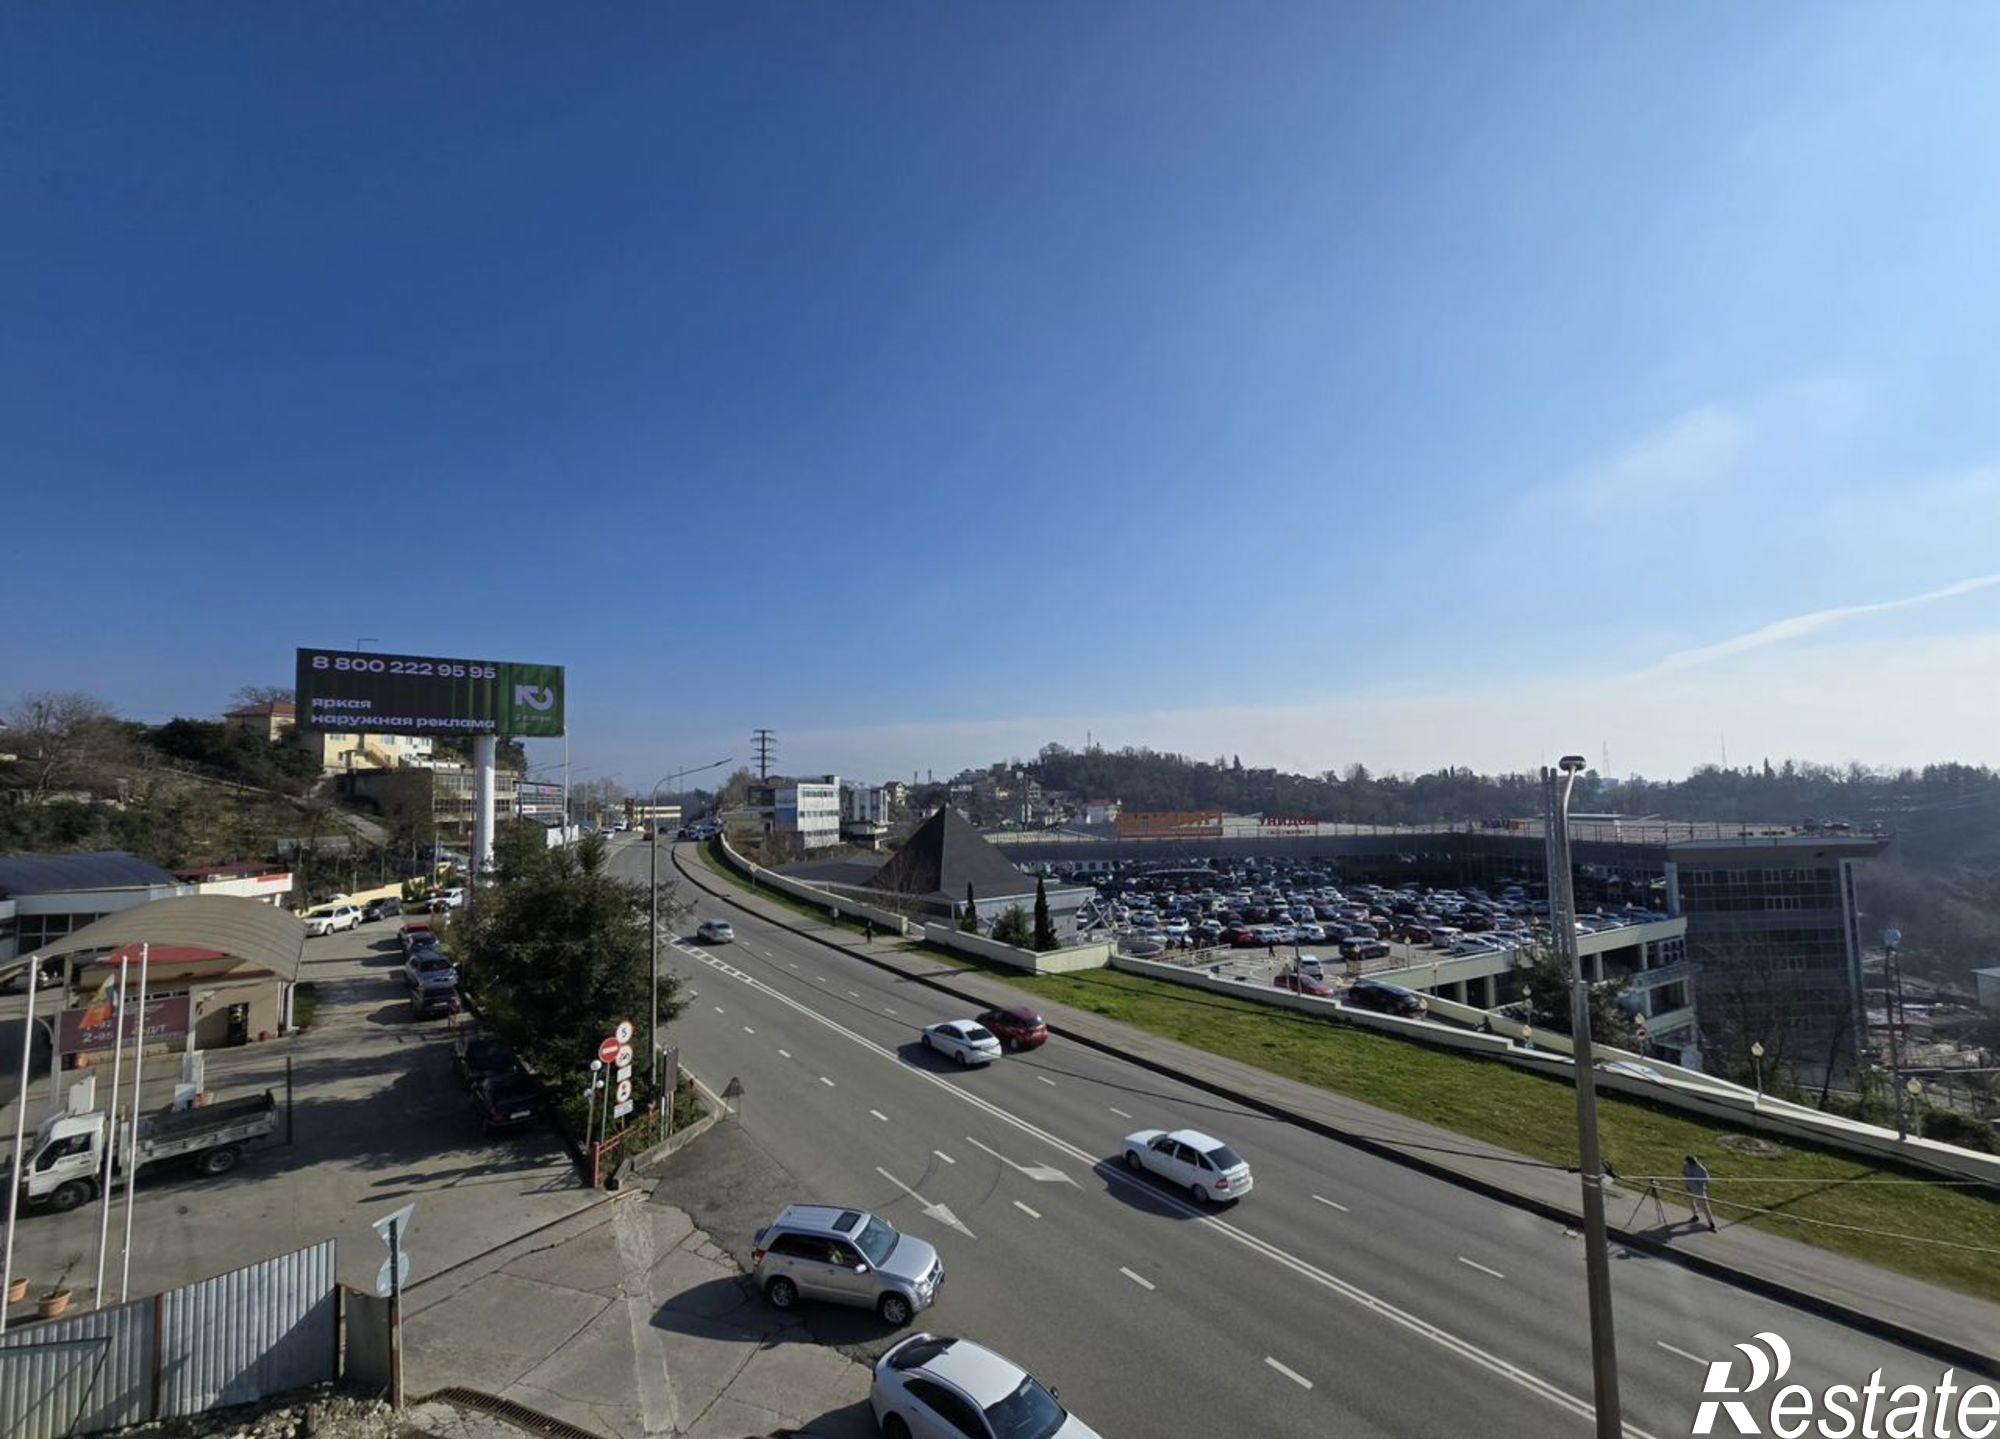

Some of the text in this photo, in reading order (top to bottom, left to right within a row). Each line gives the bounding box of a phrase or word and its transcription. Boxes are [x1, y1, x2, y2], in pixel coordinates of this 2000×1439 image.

[312, 656, 497, 679] 8 800 222 95 95
[311, 697, 372, 710] яркая
[311, 713, 495, 729] наружная реклама
